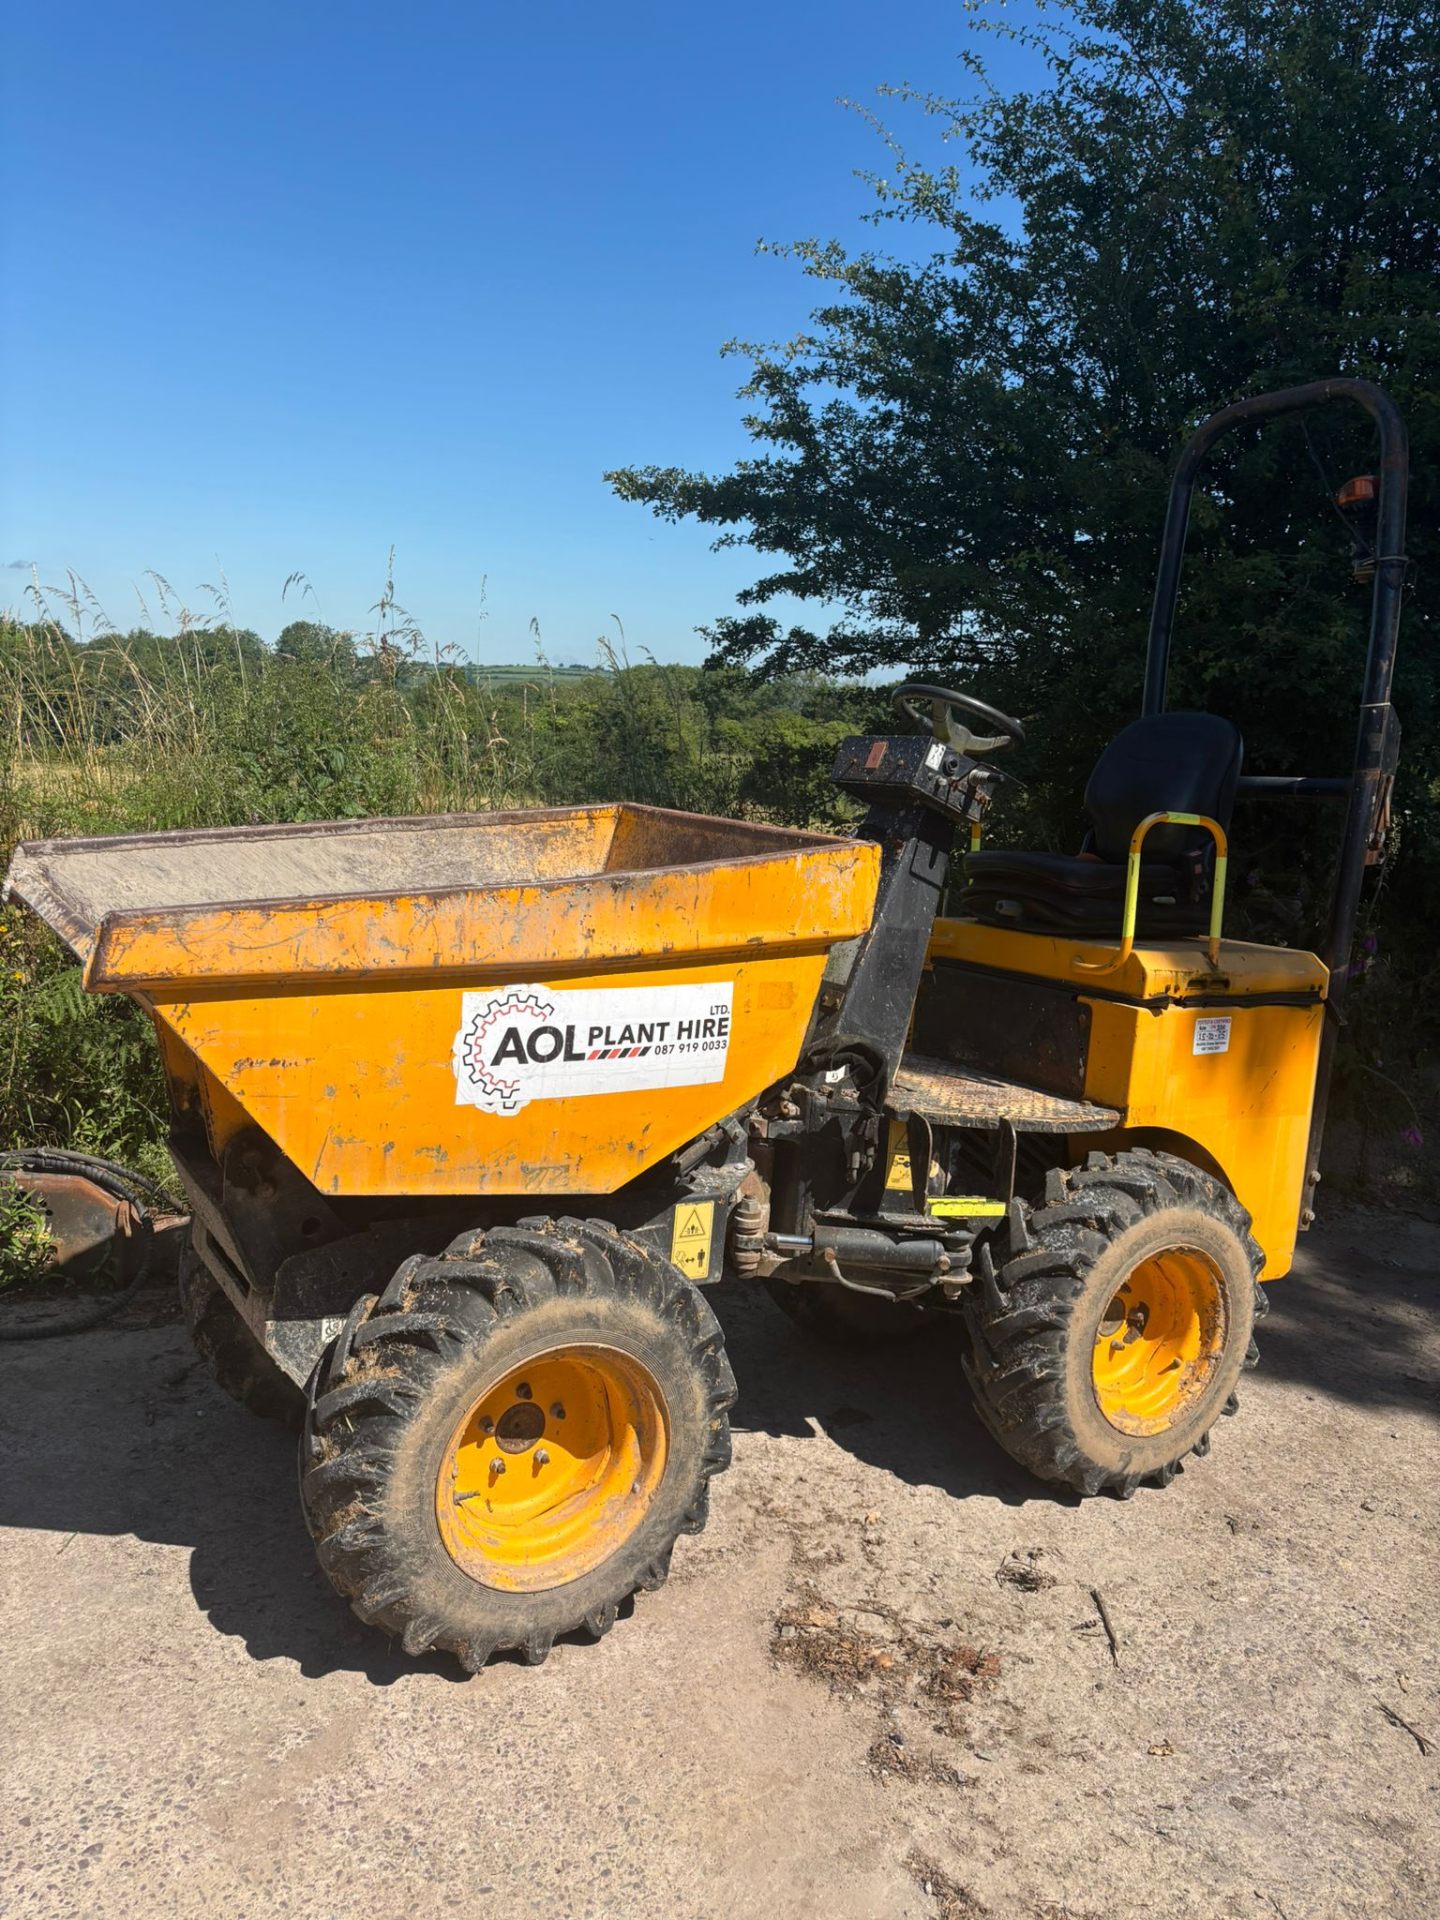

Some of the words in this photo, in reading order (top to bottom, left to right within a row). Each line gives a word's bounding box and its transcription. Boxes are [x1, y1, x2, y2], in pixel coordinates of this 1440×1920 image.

[710, 1005, 730, 1015] LTD.
[588, 1022, 670, 1046] PLANT
[677, 1017, 729, 1040] HIRE
[490, 1025, 586, 1066] AOL
[654, 1044, 675, 1055] 087
[679, 1042, 699, 1053] 919
[702, 1039, 727, 1051] 0033
